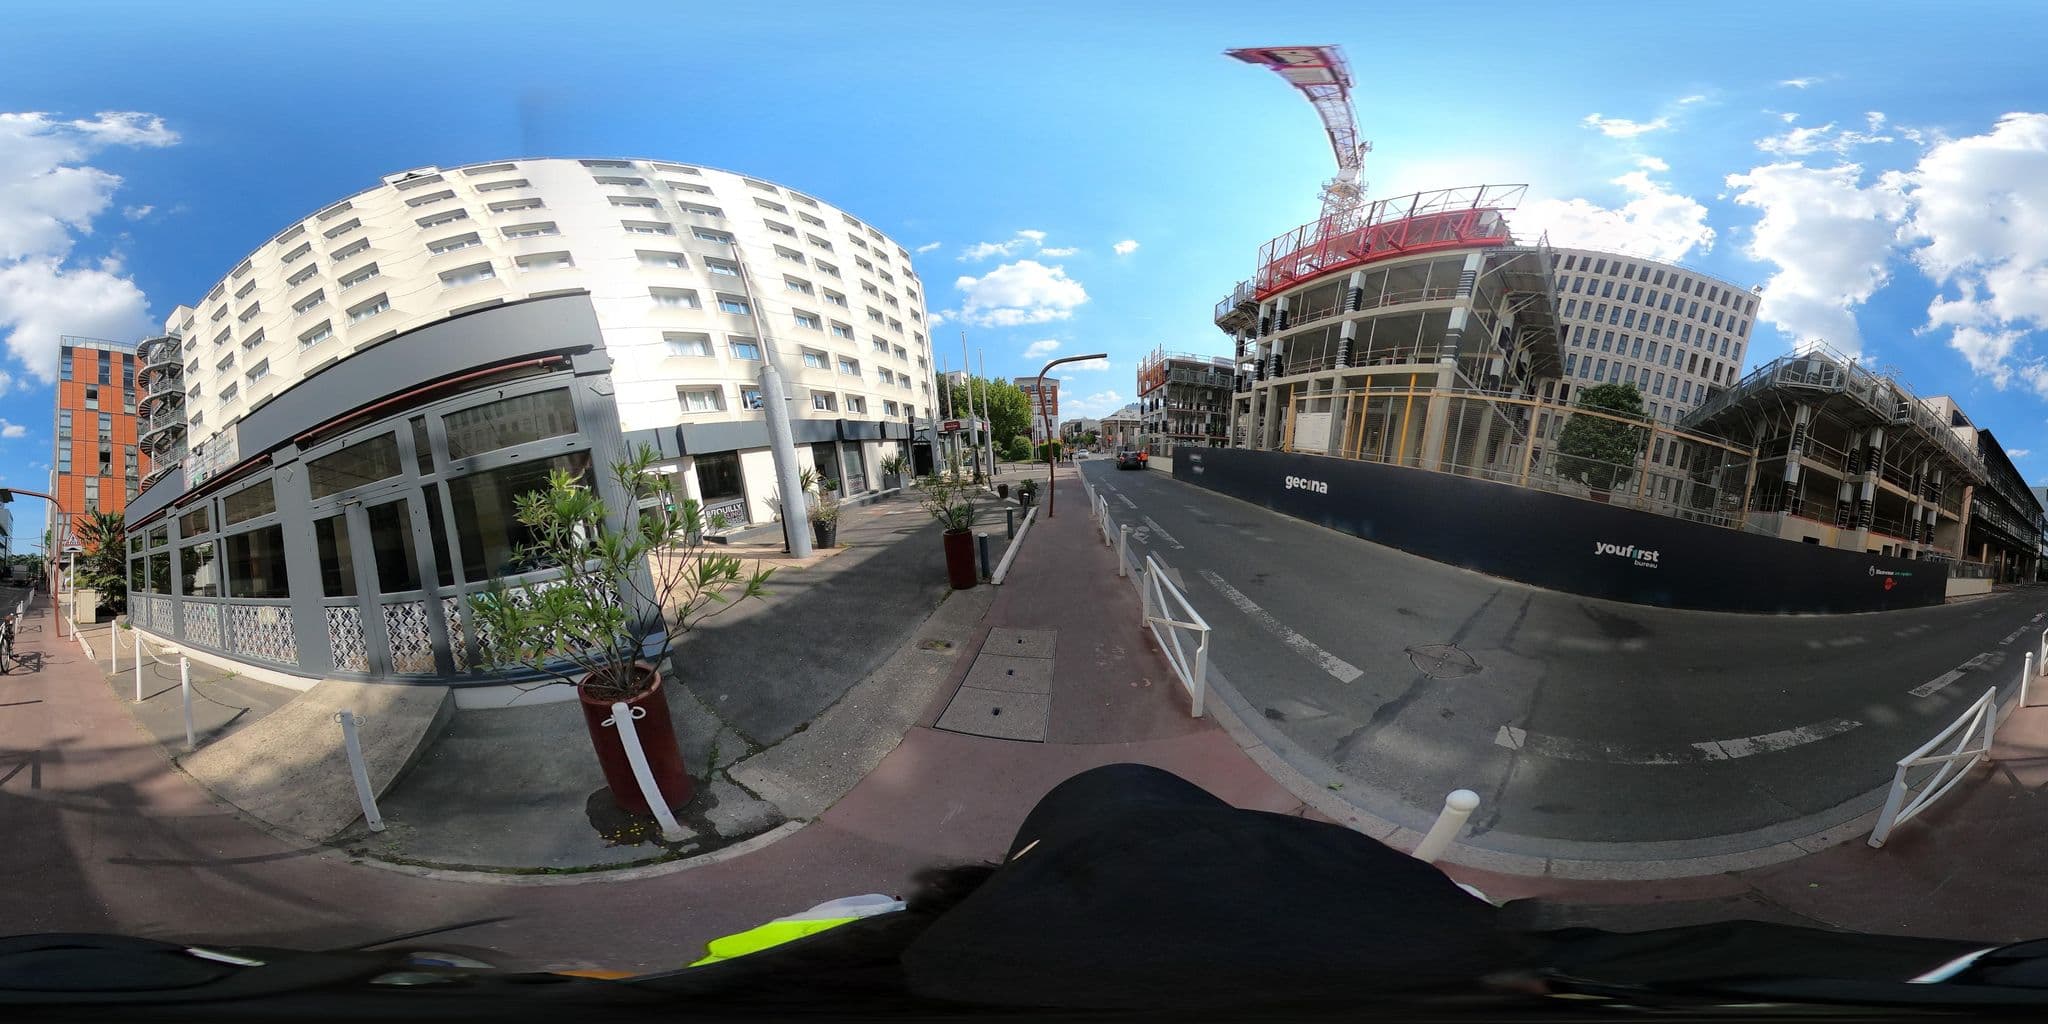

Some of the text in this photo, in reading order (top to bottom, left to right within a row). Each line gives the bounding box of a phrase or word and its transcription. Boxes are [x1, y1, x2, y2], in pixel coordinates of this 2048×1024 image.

[1285, 475, 1328, 494] gecina
[1594, 541, 1660, 562] youfirst
[1634, 559, 1658, 569] bureau
